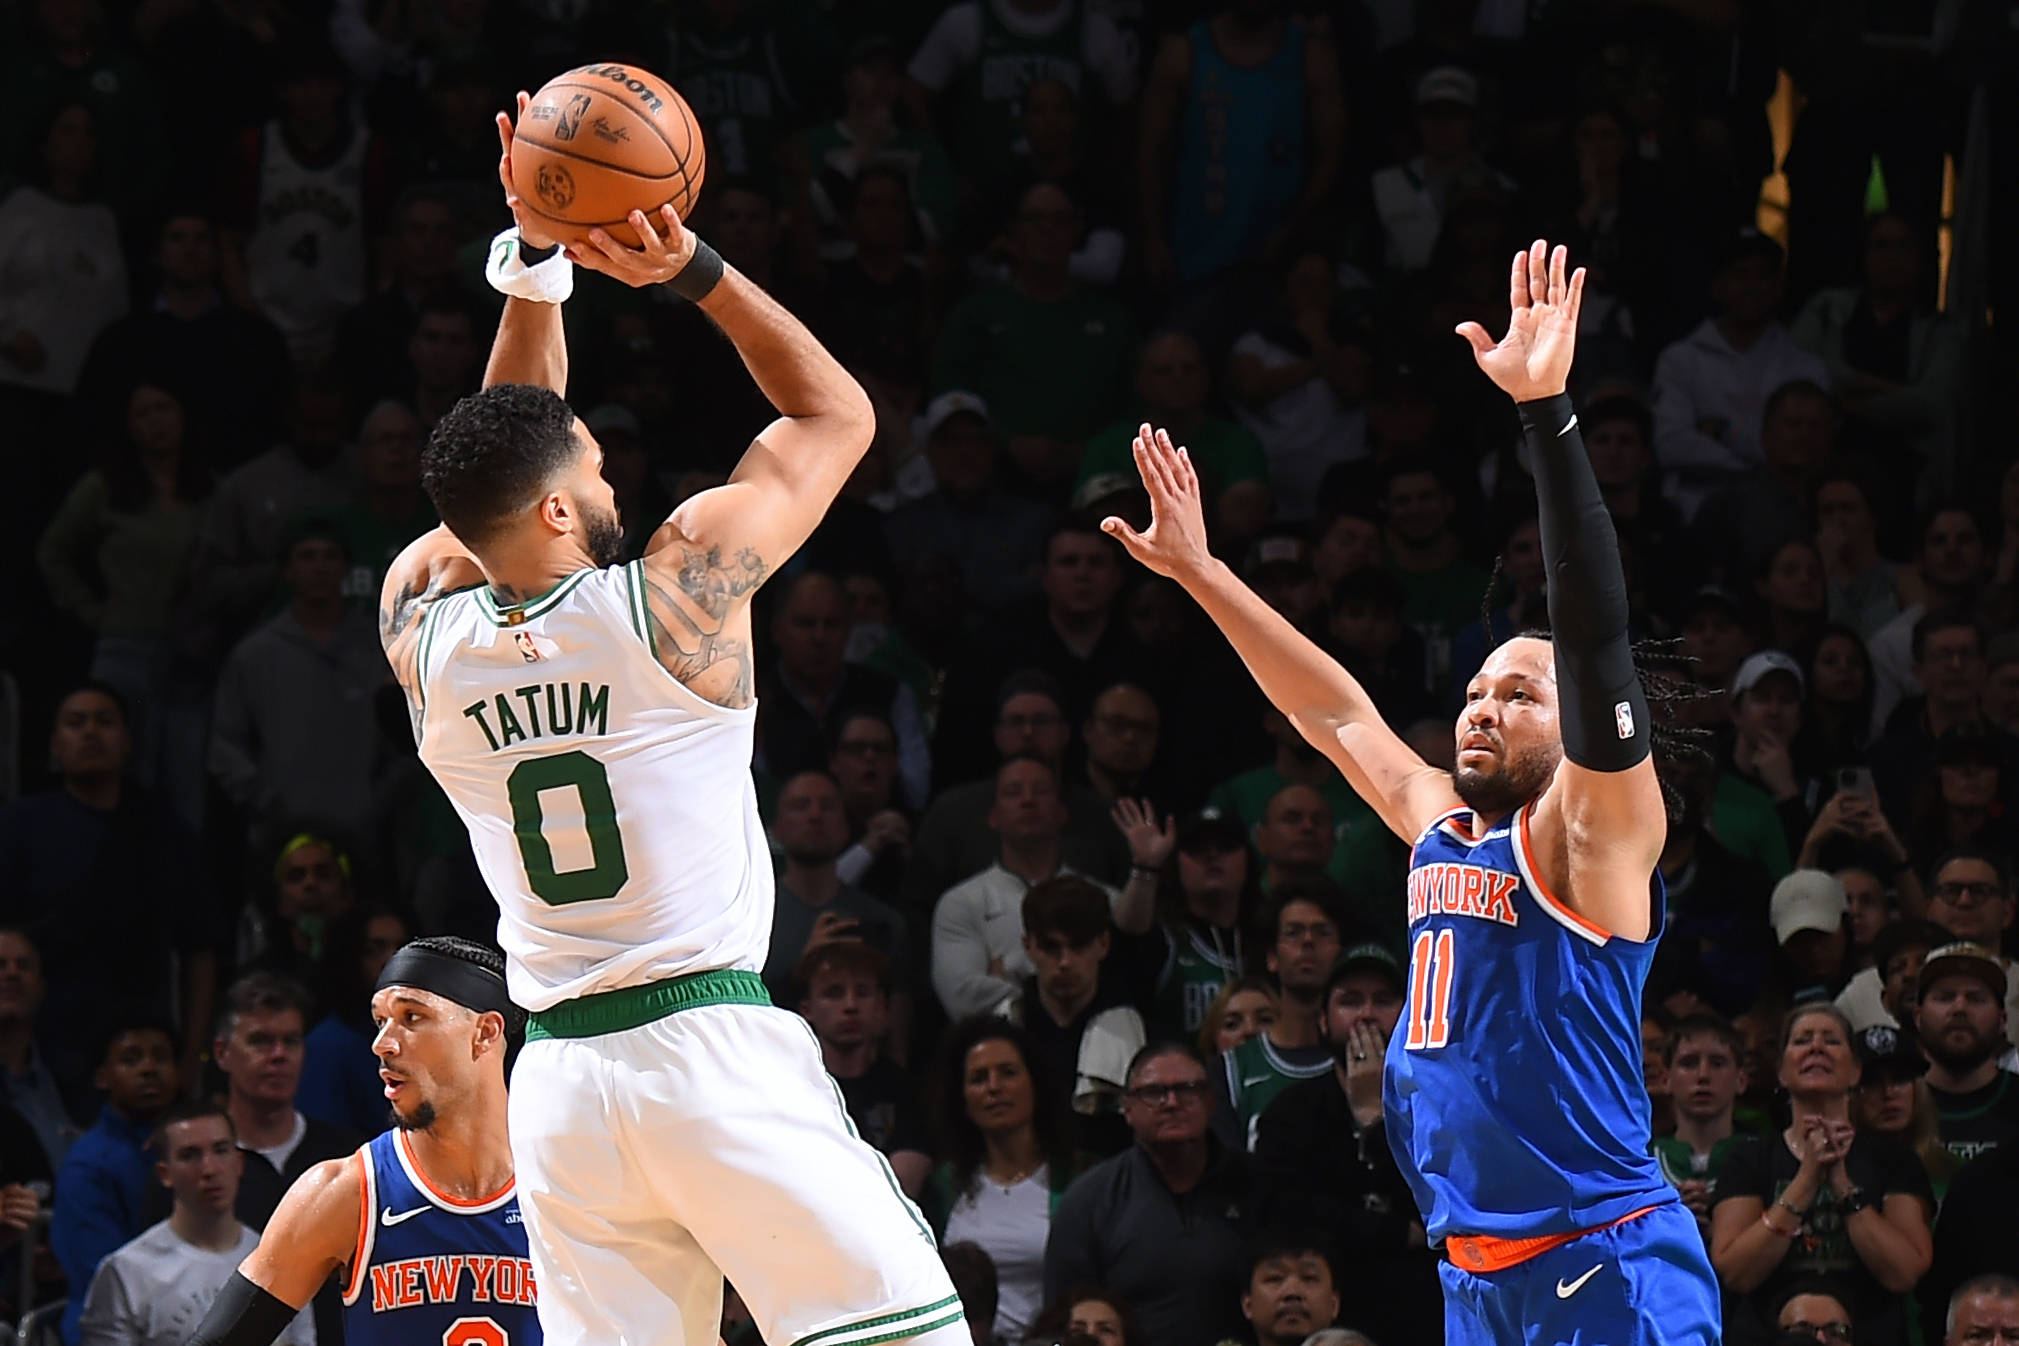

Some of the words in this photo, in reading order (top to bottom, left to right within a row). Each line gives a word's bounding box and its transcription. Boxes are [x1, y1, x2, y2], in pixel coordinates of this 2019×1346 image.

[462, 682, 610, 751] TATUM
[506, 749, 630, 907] 0
[1428, 862, 1521, 929] YORK
[1404, 928, 1454, 1051] 11
[369, 1255, 466, 1315] NEW
[465, 1253, 539, 1309] YOR
